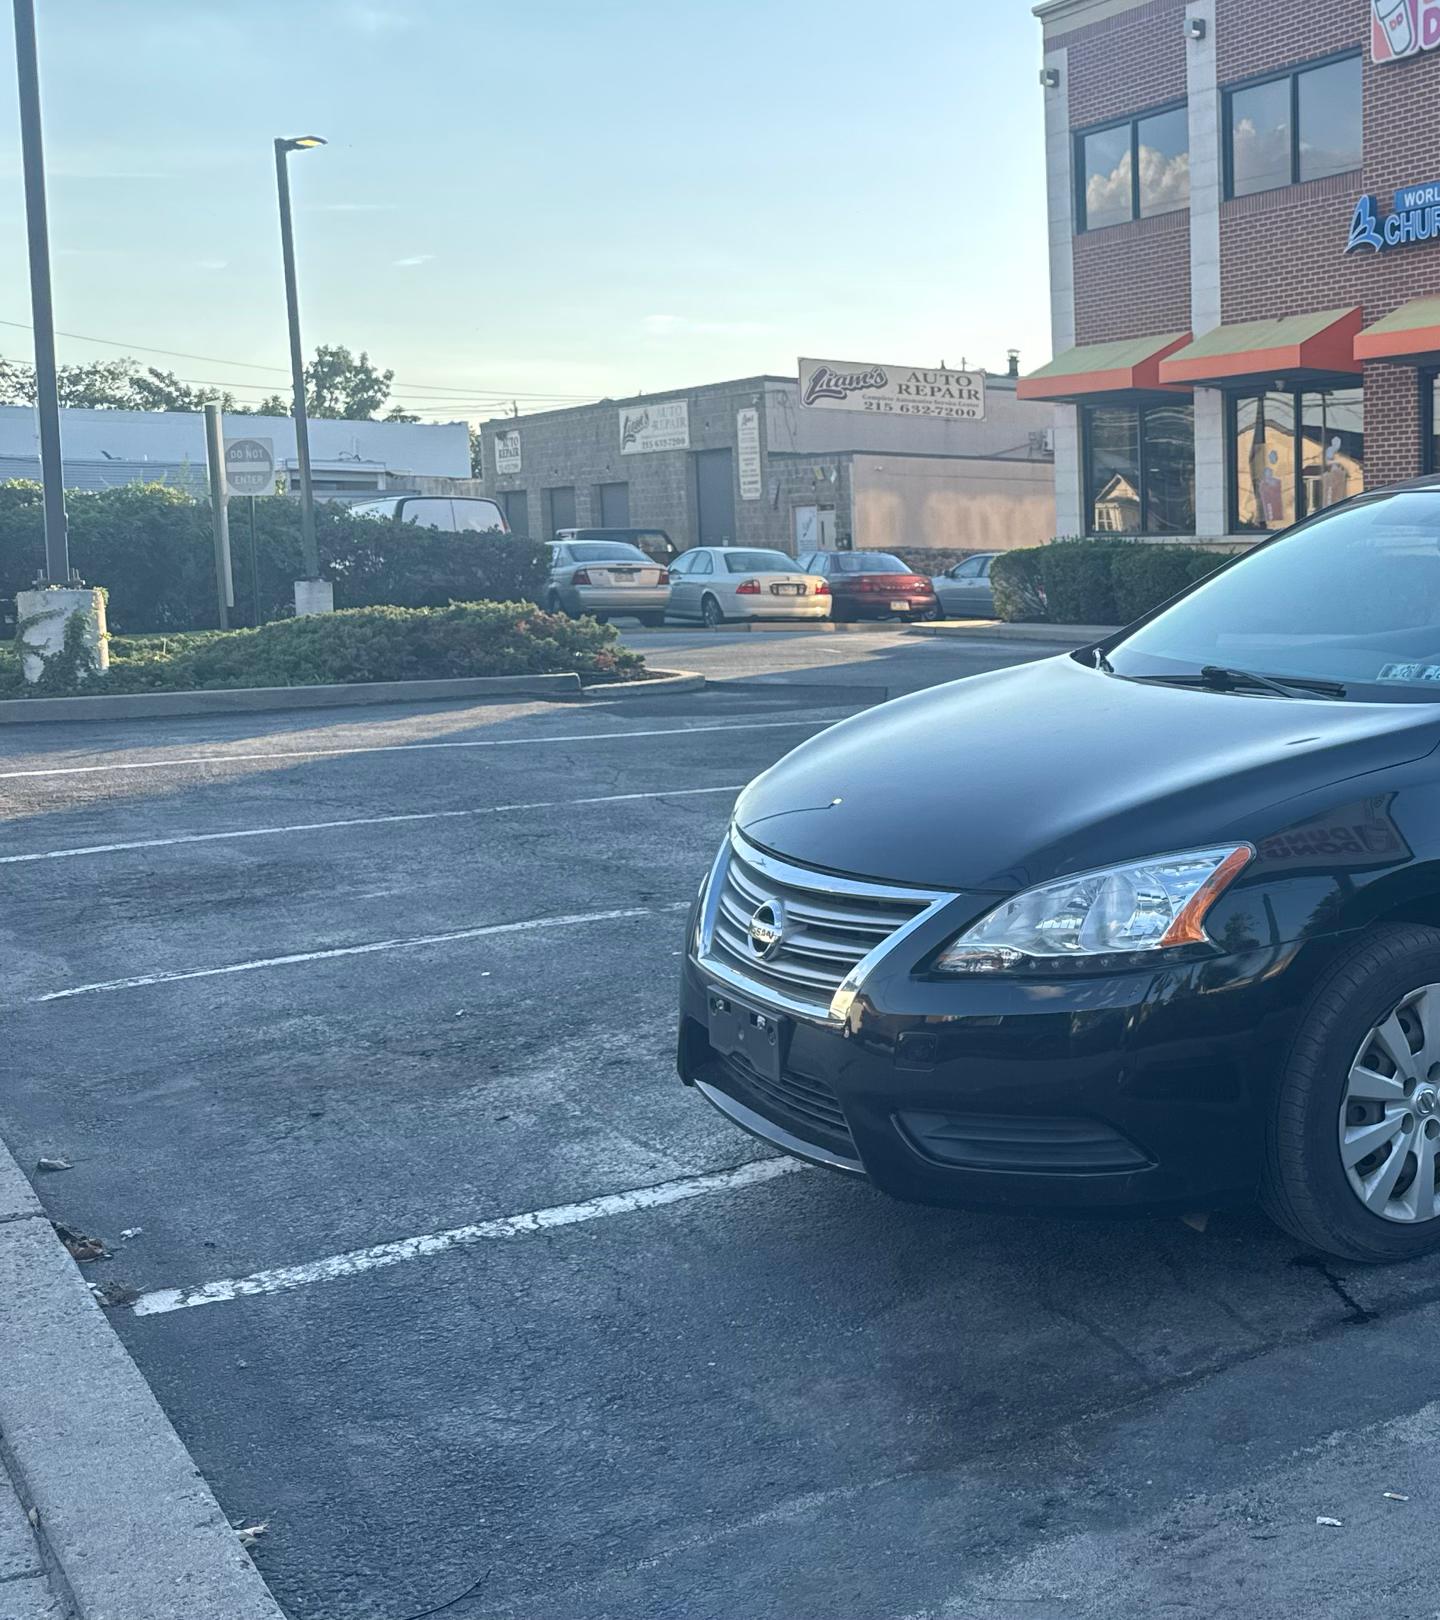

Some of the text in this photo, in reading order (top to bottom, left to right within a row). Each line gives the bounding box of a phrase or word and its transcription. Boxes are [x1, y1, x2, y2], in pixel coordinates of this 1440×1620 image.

[803, 366, 888, 406] Liam's
[906, 371, 973, 388] AUTO
[897, 383, 980, 400] REPAIR
[864, 400, 976, 418] 215 632-7200
[231, 448, 264, 459] DO NOT
[235, 475, 264, 485] ENTER
